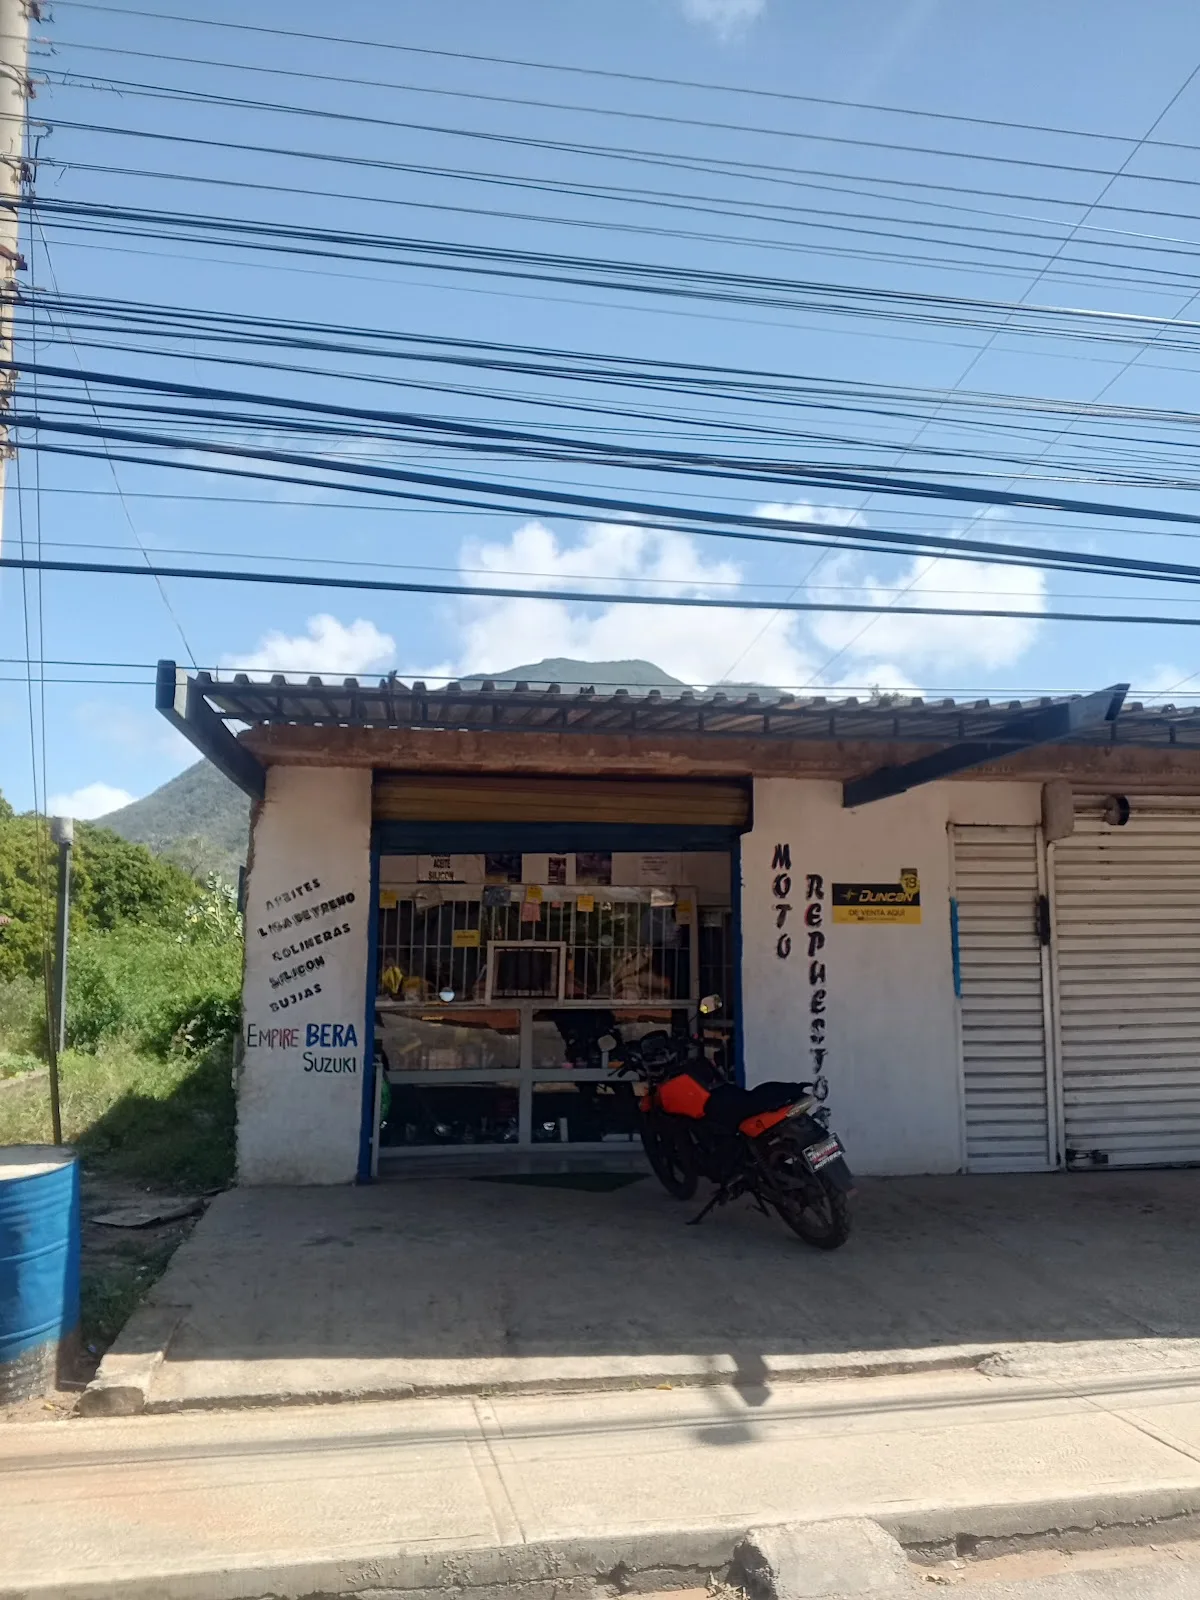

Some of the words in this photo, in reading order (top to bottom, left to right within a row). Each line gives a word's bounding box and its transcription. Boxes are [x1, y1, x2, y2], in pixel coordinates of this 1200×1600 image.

[772, 844, 792, 958] MOTO
[848, 909, 859, 917] DE
[861, 909, 885, 917] VENTA
[306, 1023, 358, 1048] BERA
